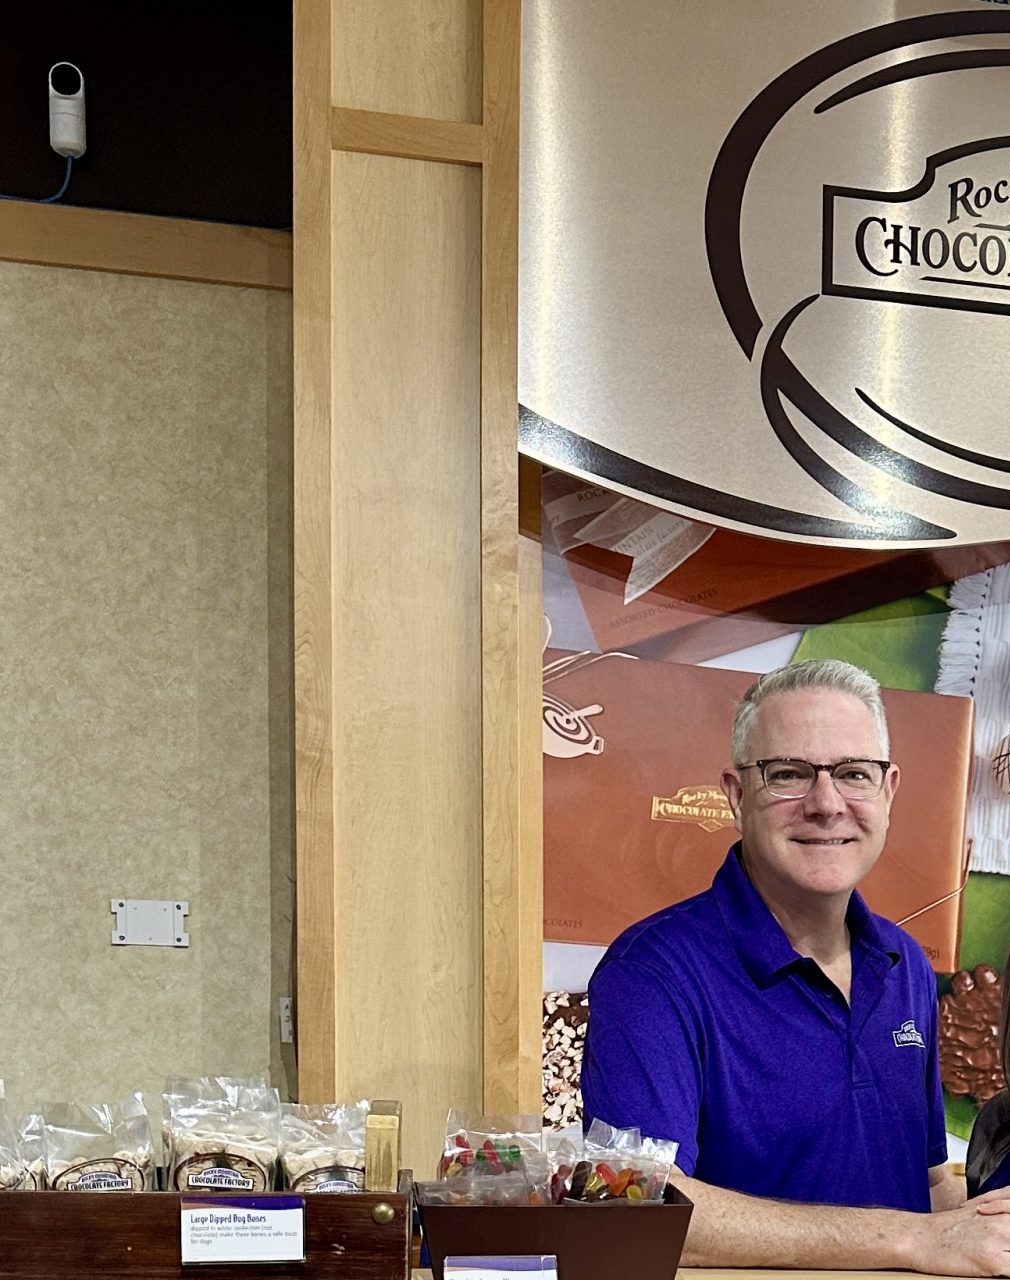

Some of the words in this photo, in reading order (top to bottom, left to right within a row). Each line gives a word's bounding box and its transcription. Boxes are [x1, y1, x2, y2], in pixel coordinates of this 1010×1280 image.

[191, 1177, 222, 1186] CHOCOLATE
[224, 1179, 250, 1187] FACTORY
[191, 1215, 208, 1225] Large
[210, 1214, 232, 1225] Dipped
[233, 1214, 246, 1224] Dog
